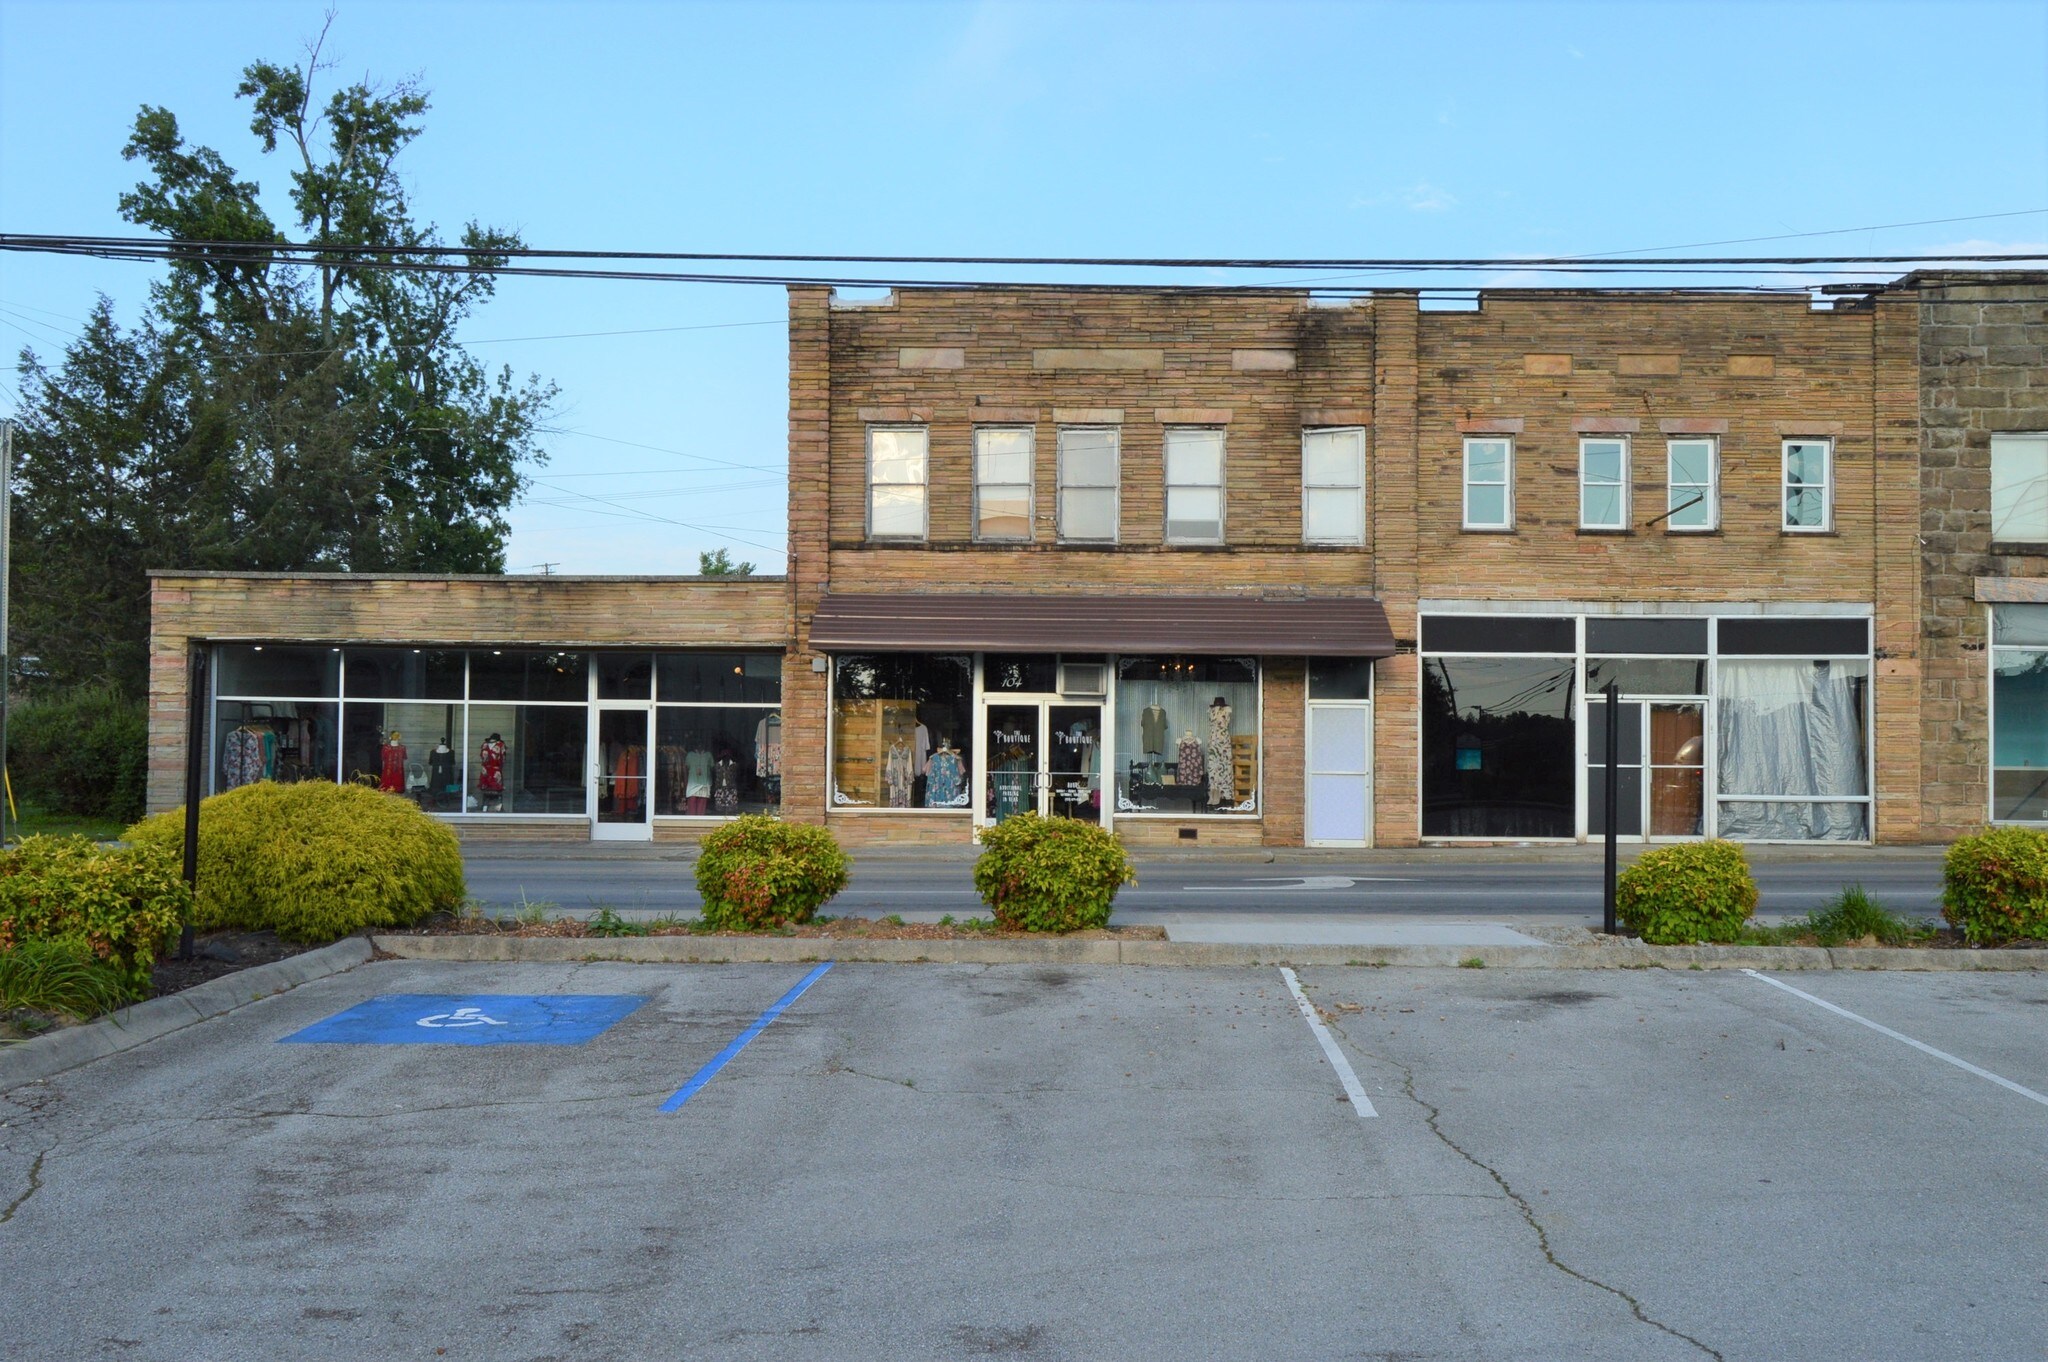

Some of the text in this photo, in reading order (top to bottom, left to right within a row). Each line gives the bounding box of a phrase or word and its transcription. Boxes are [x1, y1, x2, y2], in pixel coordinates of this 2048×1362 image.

[1001, 676, 1022, 688] 104
[1003, 734, 1031, 744] BOUTIQUE
[1065, 735, 1093, 744] BOUTIQUE
